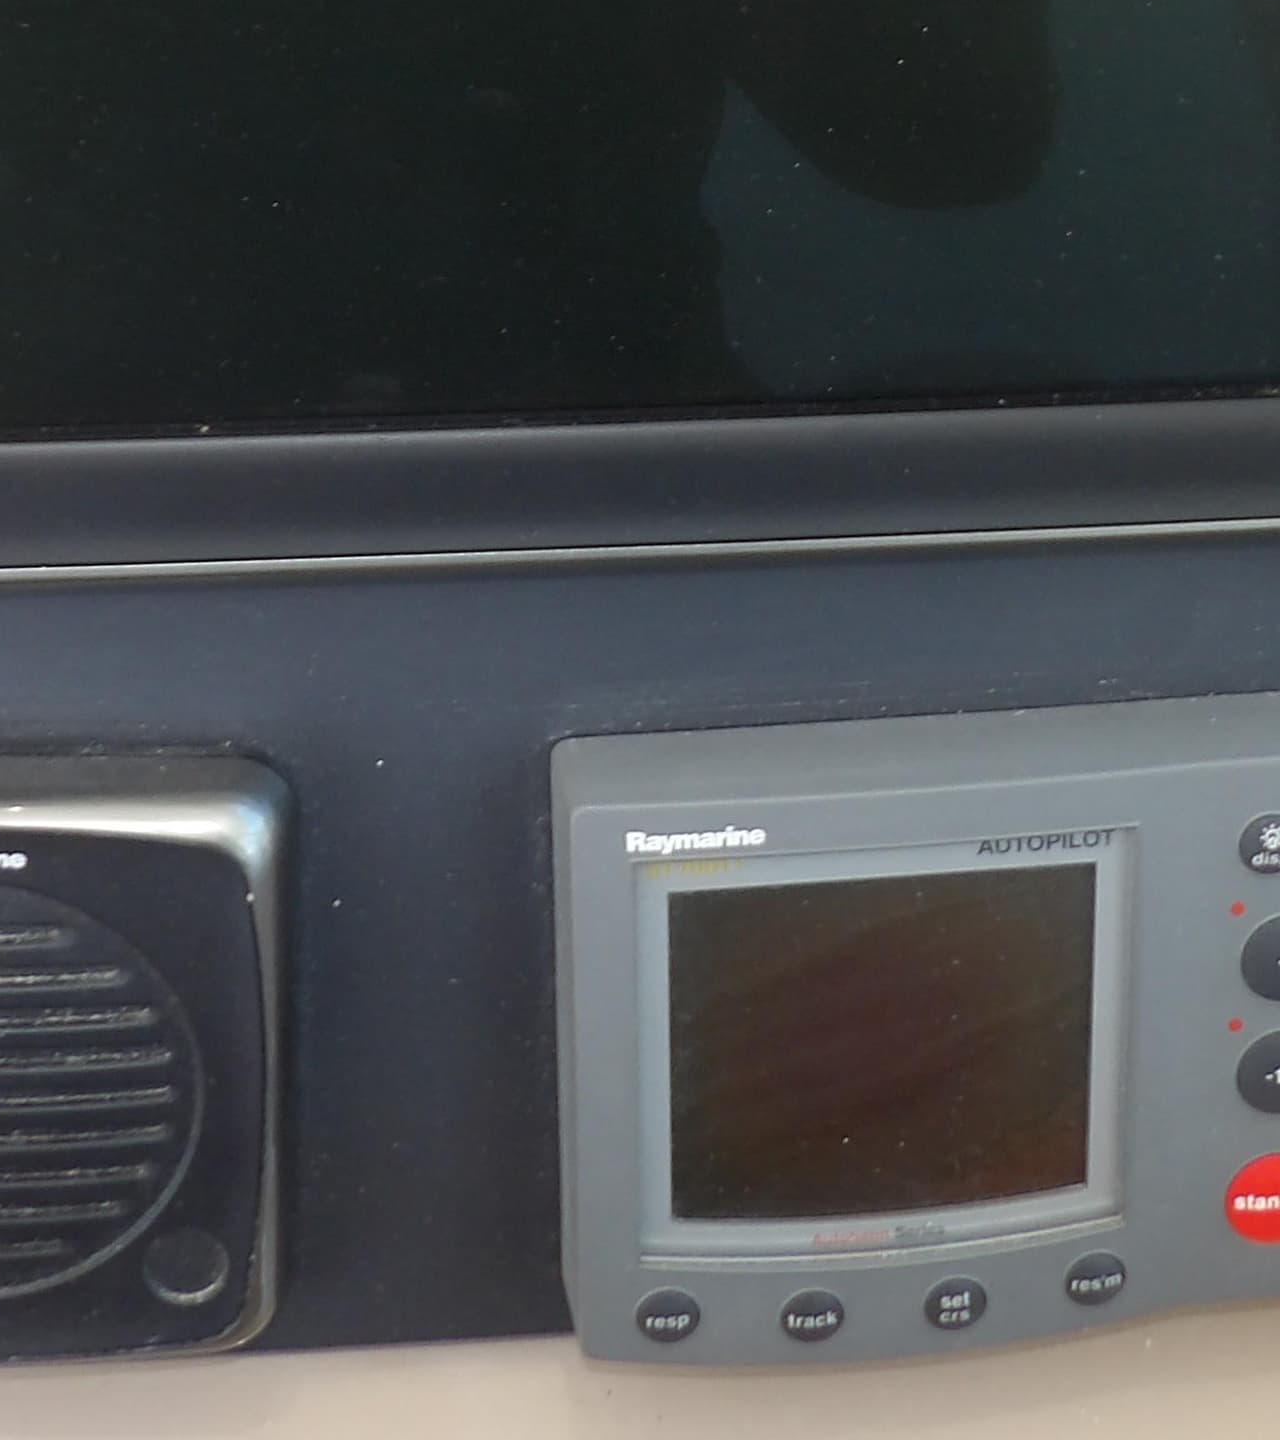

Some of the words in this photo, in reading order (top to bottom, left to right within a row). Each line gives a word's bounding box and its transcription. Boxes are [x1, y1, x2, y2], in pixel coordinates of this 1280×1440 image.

[626, 825, 766, 854] Raymarine
[976, 828, 1117, 855] AUTOPILOT
[940, 1291, 970, 1309] set
[646, 1314, 690, 1330] resp
[787, 1311, 838, 1329] track
[939, 1310, 970, 1323] crs
